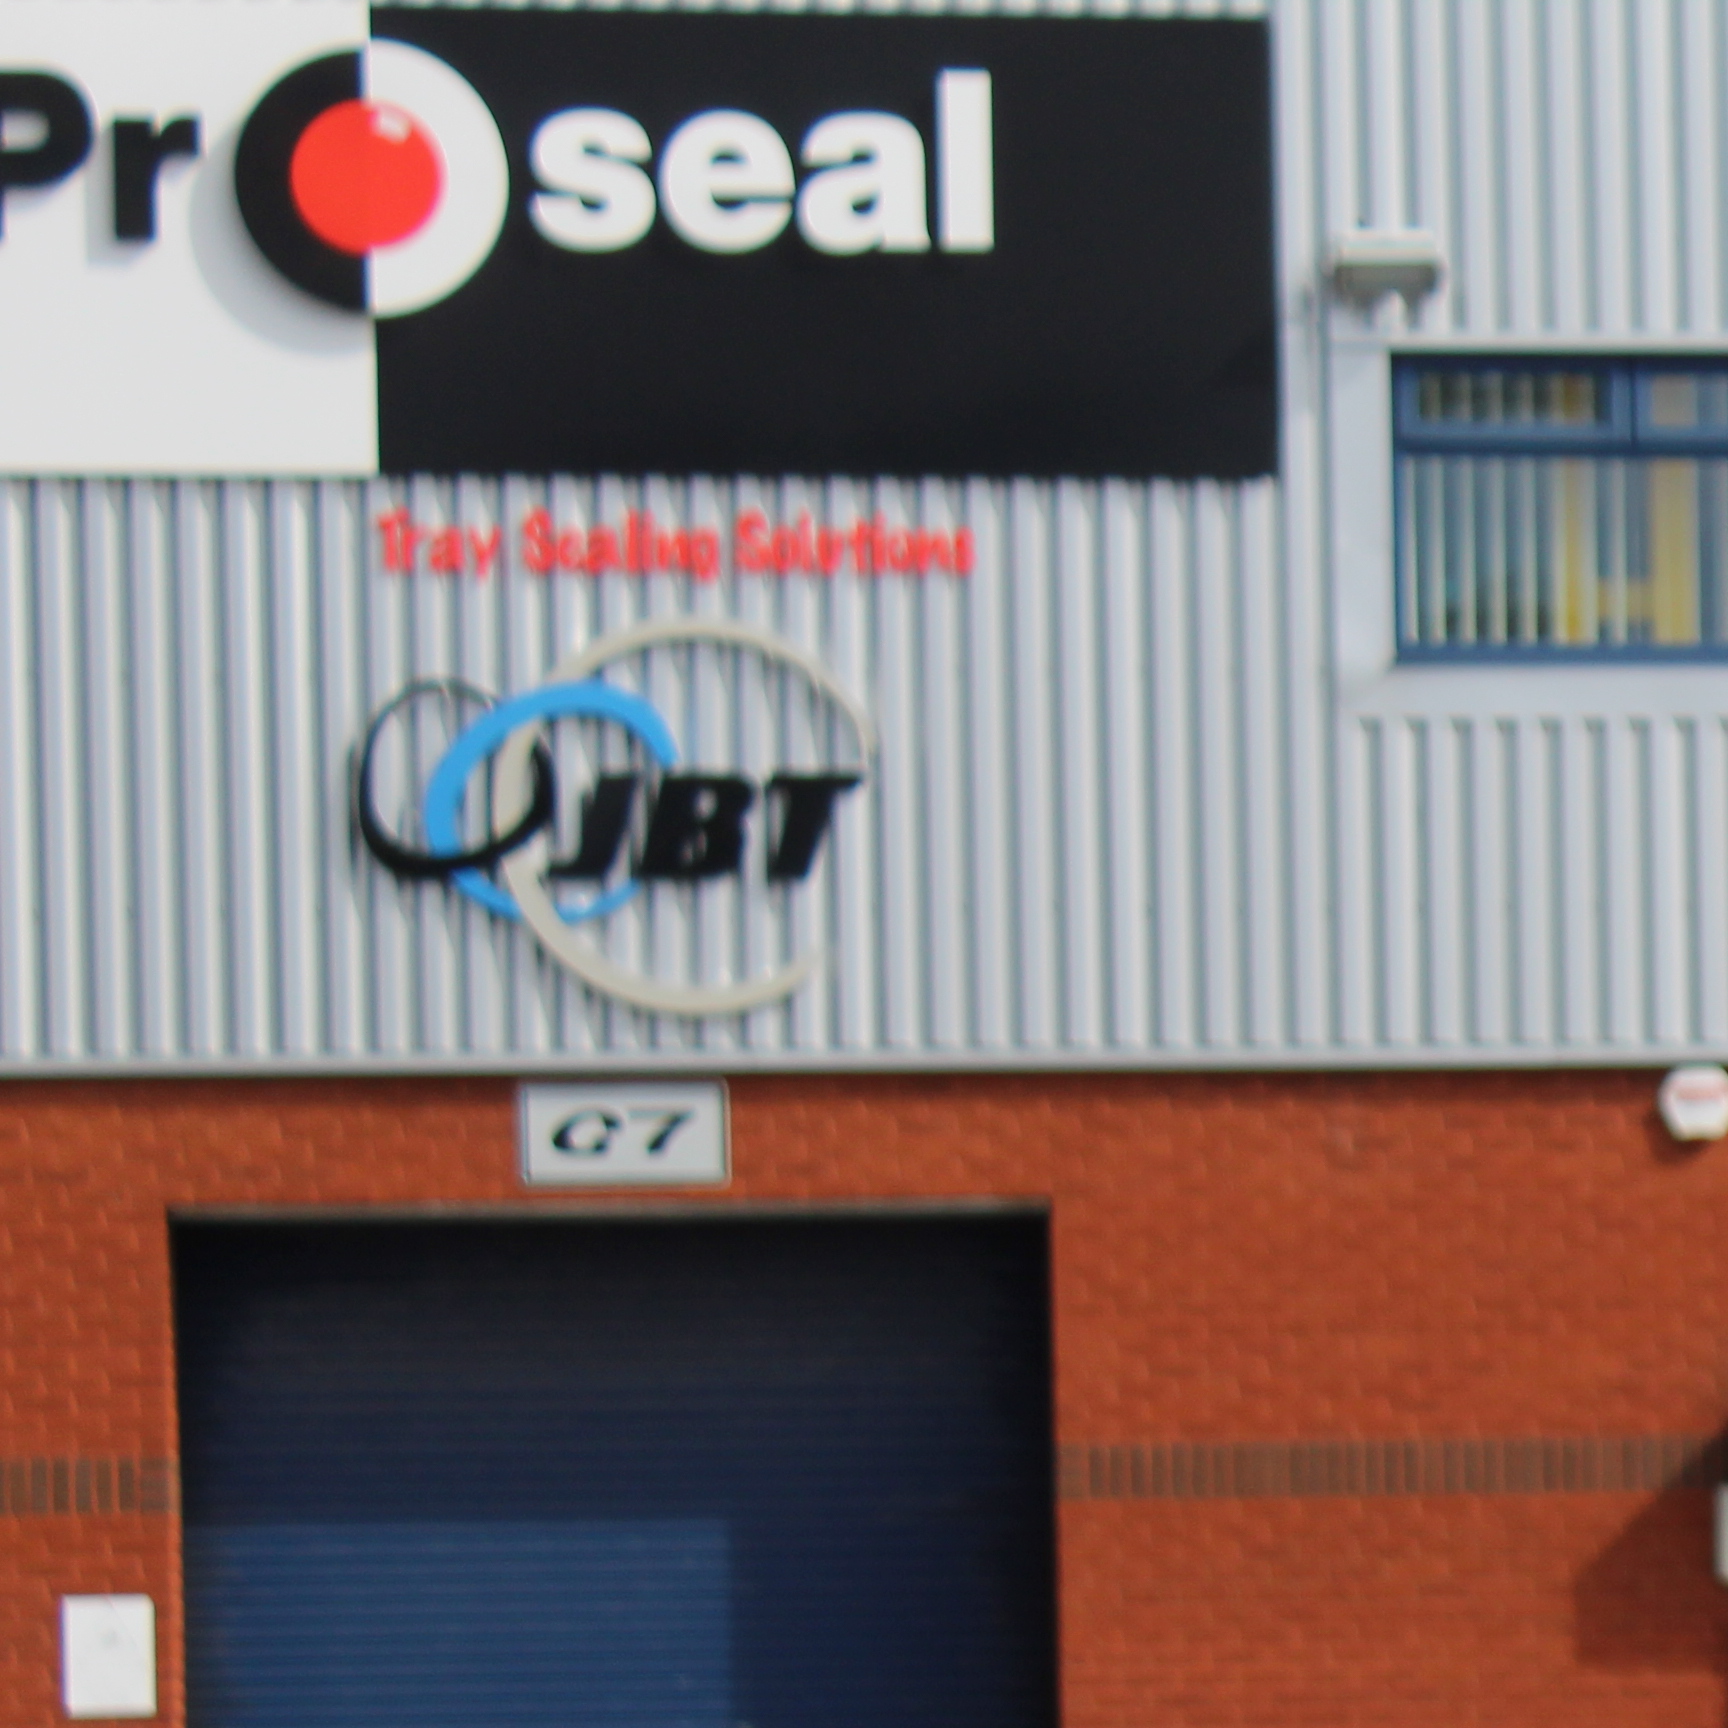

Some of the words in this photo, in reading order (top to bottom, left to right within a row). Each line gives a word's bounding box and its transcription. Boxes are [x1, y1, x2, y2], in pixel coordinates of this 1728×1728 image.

[376, 507, 502, 582] Tray
[522, 505, 720, 583] Sealing
[736, 507, 977, 576] Solutions
[544, 771, 866, 881] JBT
[551, 1107, 696, 1160] G7
